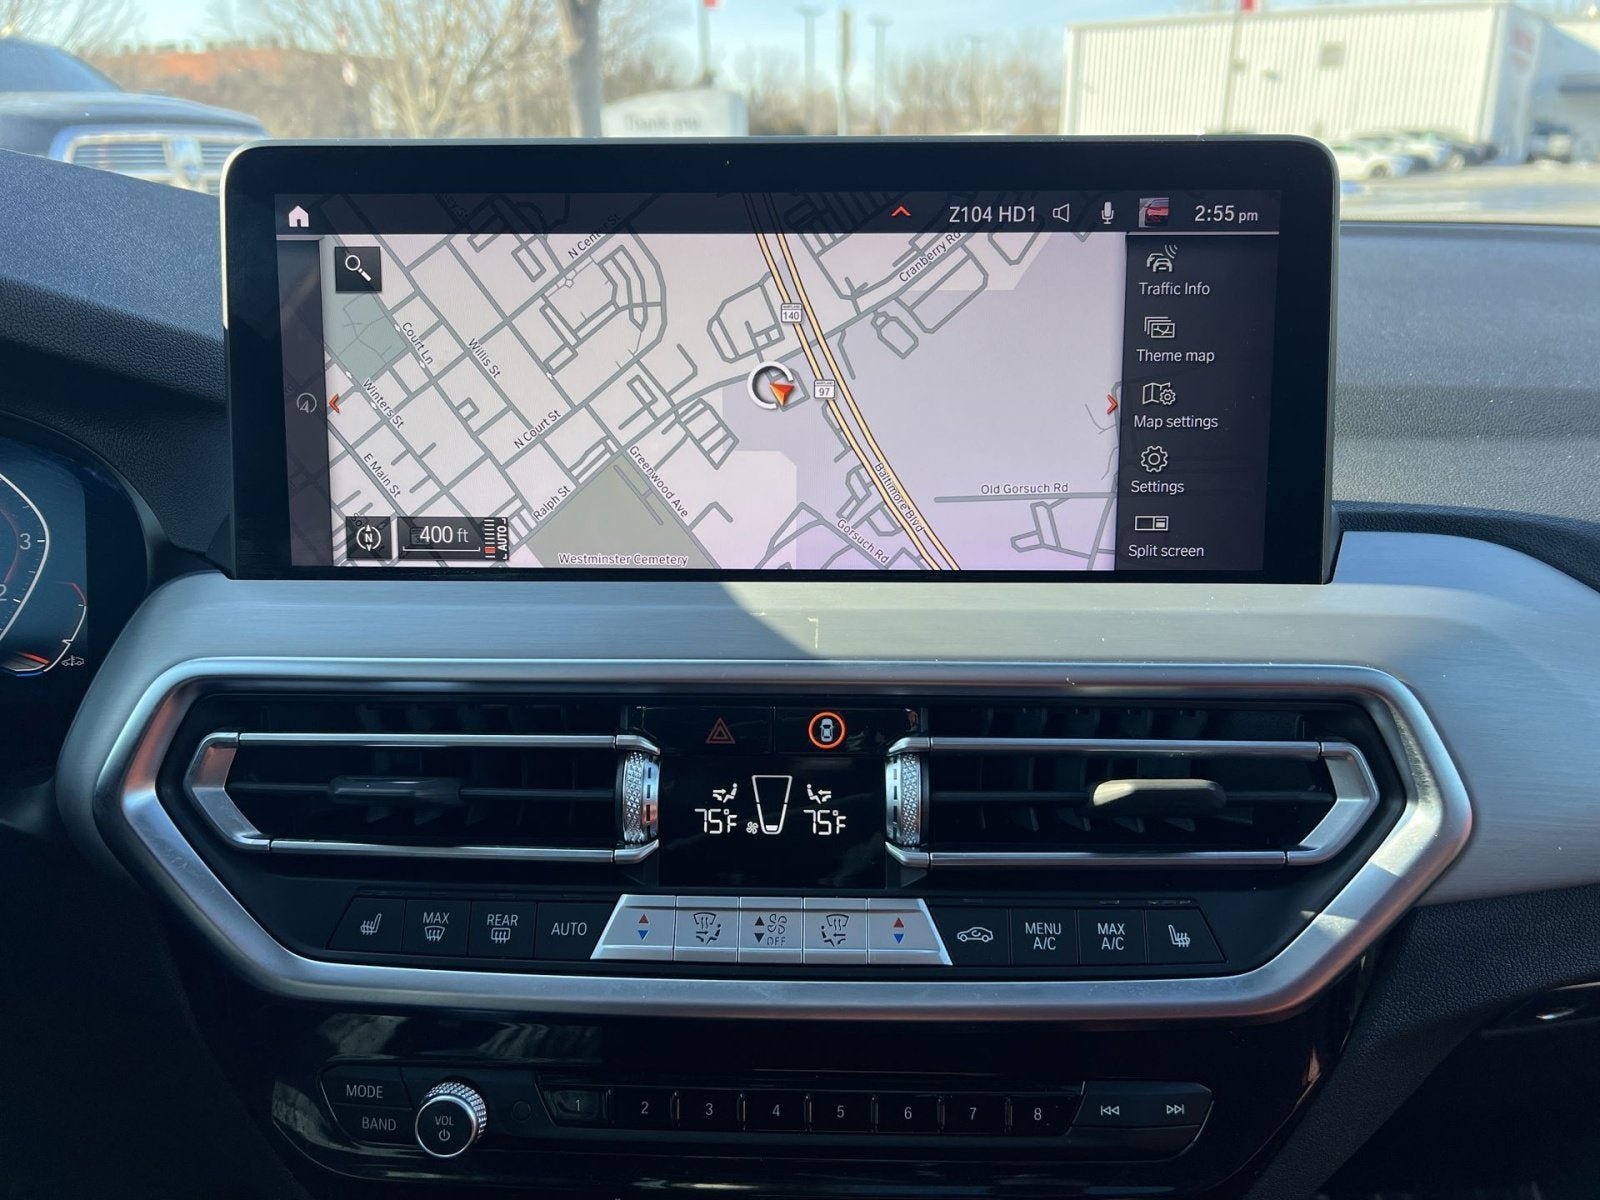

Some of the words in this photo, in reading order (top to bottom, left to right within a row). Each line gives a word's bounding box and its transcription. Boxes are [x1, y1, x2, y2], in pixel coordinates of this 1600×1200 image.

[949, 206, 993, 223] Z104
[999, 206, 1036, 223] HD1
[1194, 205, 1235, 222] 2:55
[1238, 212, 1259, 224] pm
[567, 248, 579, 260] N
[899, 241, 950, 283] Cranberry
[947, 231, 962, 246] Rd
[1138, 281, 1181, 296] Traffic
[1184, 281, 1211, 296] Info
[783, 311, 800, 321] 140
[401, 321, 424, 354] Court
[421, 347, 434, 365] Ln
[468, 337, 491, 368] Willis
[486, 361, 501, 379] St
[1136, 348, 1182, 363] Theme
[1185, 350, 1215, 364] map
[818, 387, 830, 397] 97
[363, 378, 393, 416] Winters
[391, 412, 405, 430] St
[513, 438, 524, 449] N
[522, 417, 550, 443] Court
[546, 409, 562, 424] St
[1133, 415, 1163, 430] Map
[1166, 415, 1219, 430] settings
[363, 453, 373, 465] E
[369, 460, 393, 488] Main
[388, 483, 402, 498] St
[629, 445, 675, 500] Greenwood
[671, 497, 689, 518] Ave
[980, 483, 1001, 494] Old
[1002, 483, 1051, 494] Gorsuch
[1053, 482, 1069, 493] Rd
[1130, 480, 1185, 495] Settings
[533, 494, 561, 521] Ralph
[558, 485, 571, 498] St
[874, 462, 909, 512] Baltimore
[904, 507, 925, 533] Blvd
[20, 533, 32, 550] 3
[419, 526, 453, 543] 400
[457, 528, 469, 543] ft
[498, 525, 507, 551] AUTO
[837, 518, 877, 553] Gorsuch
[874, 549, 890, 564] Rd
[1128, 544, 1157, 559] Split
[1160, 547, 1205, 557] screen
[558, 553, 631, 564] Westminster
[633, 553, 689, 566] Cemetery
[422, 911, 450, 925] MAX
[486, 914, 519, 927] REAR
[551, 922, 588, 936] AUTO
[1025, 922, 1062, 935] MENU
[1097, 922, 1126, 936] MAX
[767, 936, 786, 946] OFF
[1033, 937, 1057, 951] A/C
[1101, 937, 1125, 951] A/C
[345, 1083, 384, 1099] MODE
[575, 1099, 581, 1112] 1
[640, 1101, 649, 1114] 2
[704, 1103, 714, 1116] 3
[771, 1104, 781, 1118] 4
[836, 1105, 845, 1119] 5
[903, 1106, 913, 1120] 6
[968, 1107, 978, 1121] 7
[1033, 1108, 1043, 1122] 8
[361, 1116, 397, 1131] BAND
[434, 1115, 455, 1126] VOL
